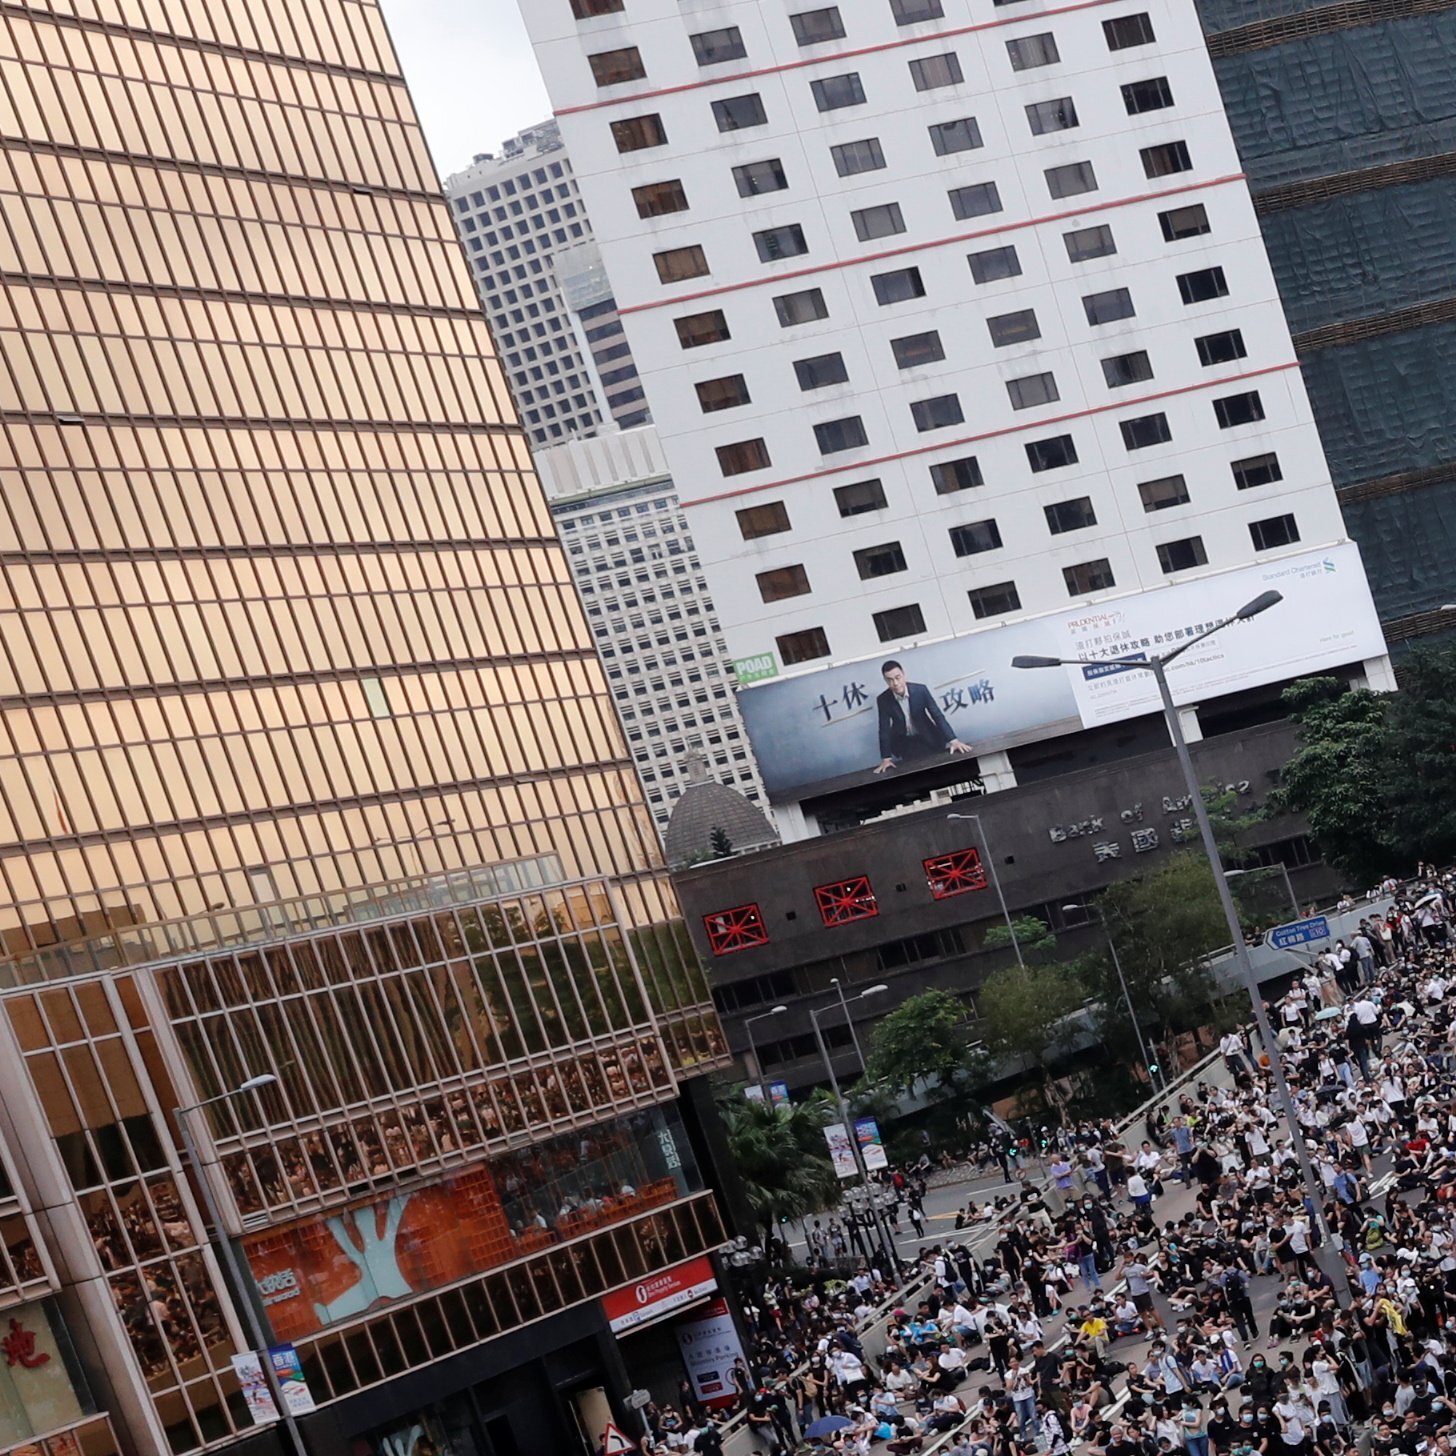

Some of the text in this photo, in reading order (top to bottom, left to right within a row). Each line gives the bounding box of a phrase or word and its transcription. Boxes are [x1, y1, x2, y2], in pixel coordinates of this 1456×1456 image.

[1067, 613, 1109, 629] PRUDENTIAL
[737, 656, 773, 675] POAD
[1120, 803, 1143, 824] of
